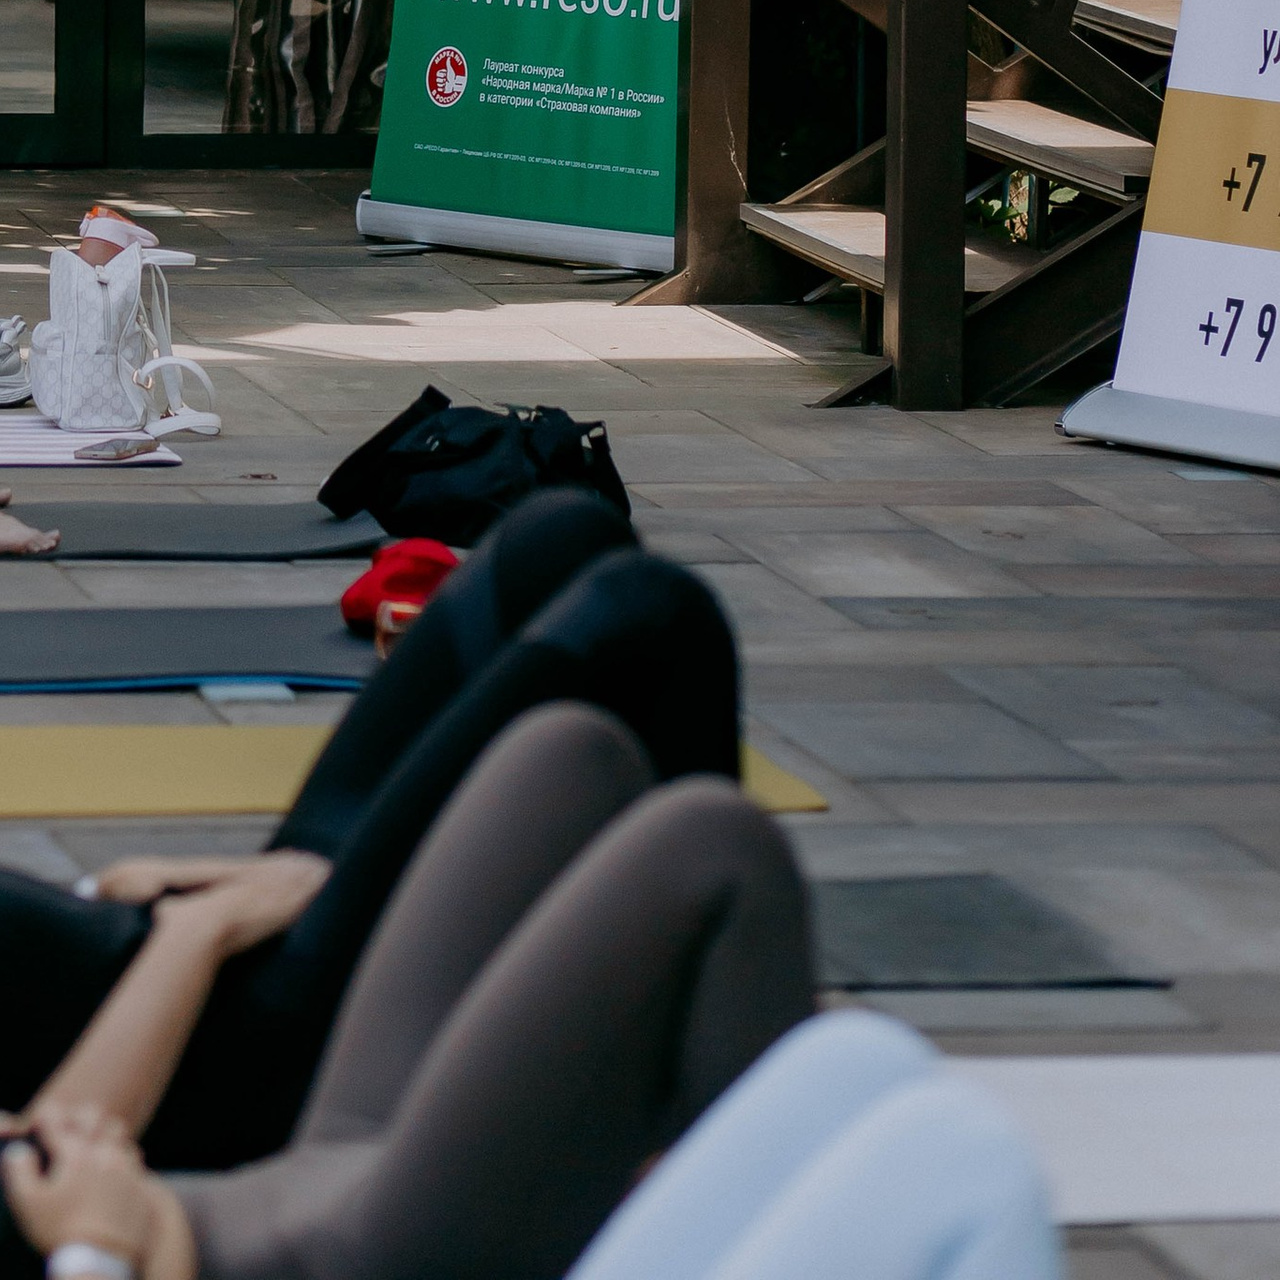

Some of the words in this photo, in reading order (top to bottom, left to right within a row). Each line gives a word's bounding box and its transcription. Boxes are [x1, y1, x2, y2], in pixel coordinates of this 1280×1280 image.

[435, 50, 455, 64] МАРКА
[483, 58, 519, 73] Лауреат
[521, 64, 564, 79] конкурса
[436, 91, 458, 104] РОССИИ
[482, 75, 530, 91] «Народная
[533, 82, 594, 98] марка/Марка
[596, 86, 608, 98] №
[611, 88, 615, 99] 1
[618, 91, 624, 100] в
[626, 89, 664, 104] России»
[480, 93, 485, 102] в
[487, 94, 533, 108] категории
[536, 97, 588, 113] «Страховая
[589, 105, 641, 118] компания»
[1223, 152, 1267, 212] +7
[1199, 297, 1245, 357] +7
